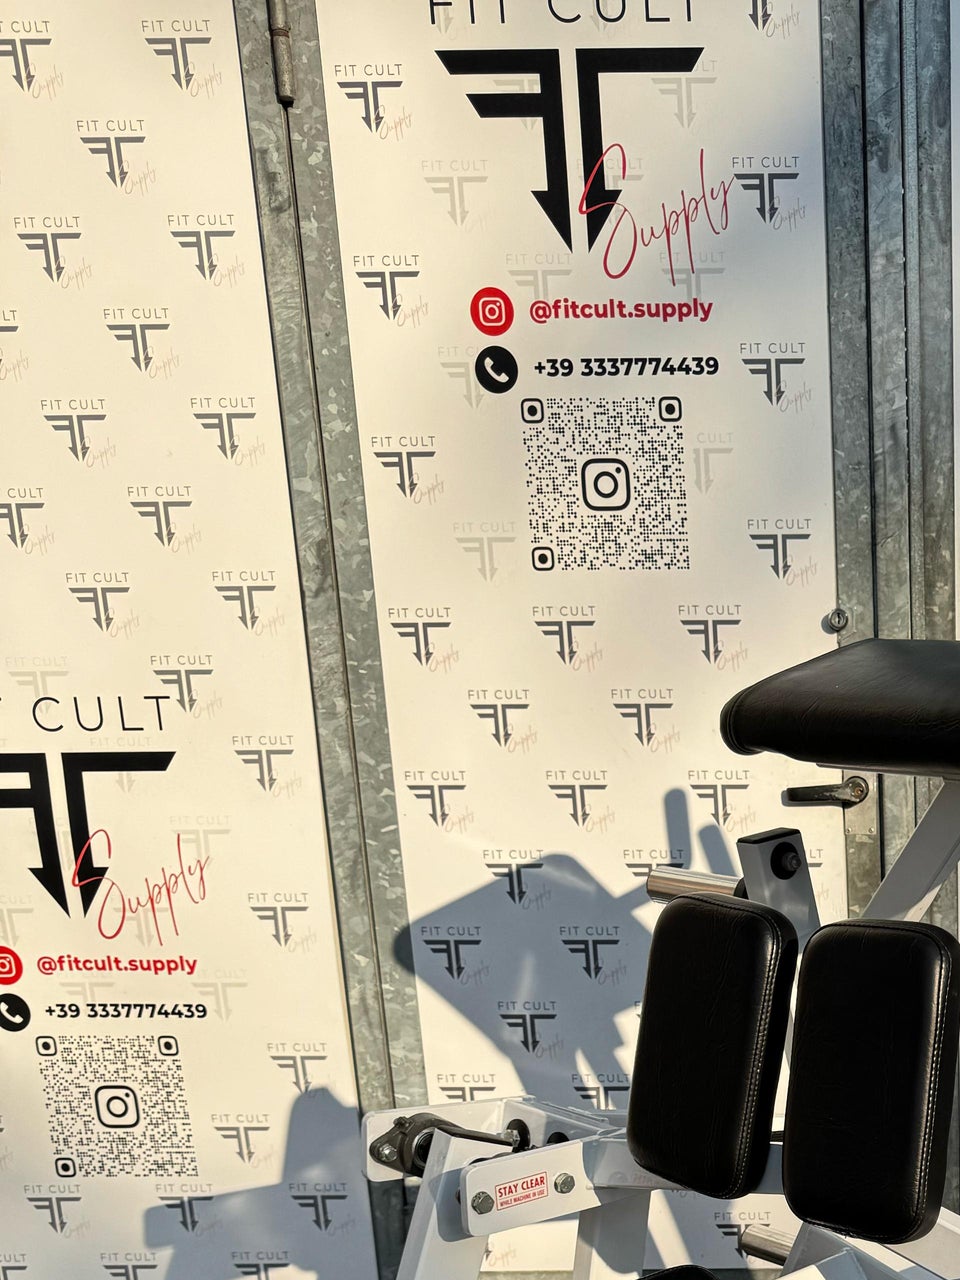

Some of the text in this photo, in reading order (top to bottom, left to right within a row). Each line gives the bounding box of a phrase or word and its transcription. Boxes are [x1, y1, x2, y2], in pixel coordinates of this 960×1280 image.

[141, 19, 211, 33] FIT CULT
[334, 63, 403, 77] FIT CULT
[76, 119, 145, 132] FIT CULT
[731, 156, 800, 169] FIT CULT
[167, 213, 235, 227] FIT CULT
[578, 143, 735, 287] Supply
[529, 297, 714, 324] @fitcult.supply
[739, 342, 806, 355] FIT CULT
[534, 356, 720, 377] +39 3337774439
[40, 398, 105, 411] FIT CULT
[370, 435, 436, 448] FIT CULT
[747, 518, 812, 530] FIT CULT
[65, 571, 129, 584] FIT CULT
[387, 606, 451, 619] FIT CULT
[150, 654, 213, 666] FIT CULT
[467, 688, 530, 700] FIT CULT
[31, 695, 171, 732] CULT
[71, 829, 210, 946] Supply
[420, 925, 482, 937] FIT CULT
[559, 925, 620, 937] FIT CULT
[36, 955, 198, 976] @fitcult.supply
[45, 1002, 208, 1020] +39 3337774439
[498, 1176, 545, 1197] STAY CLEAR
